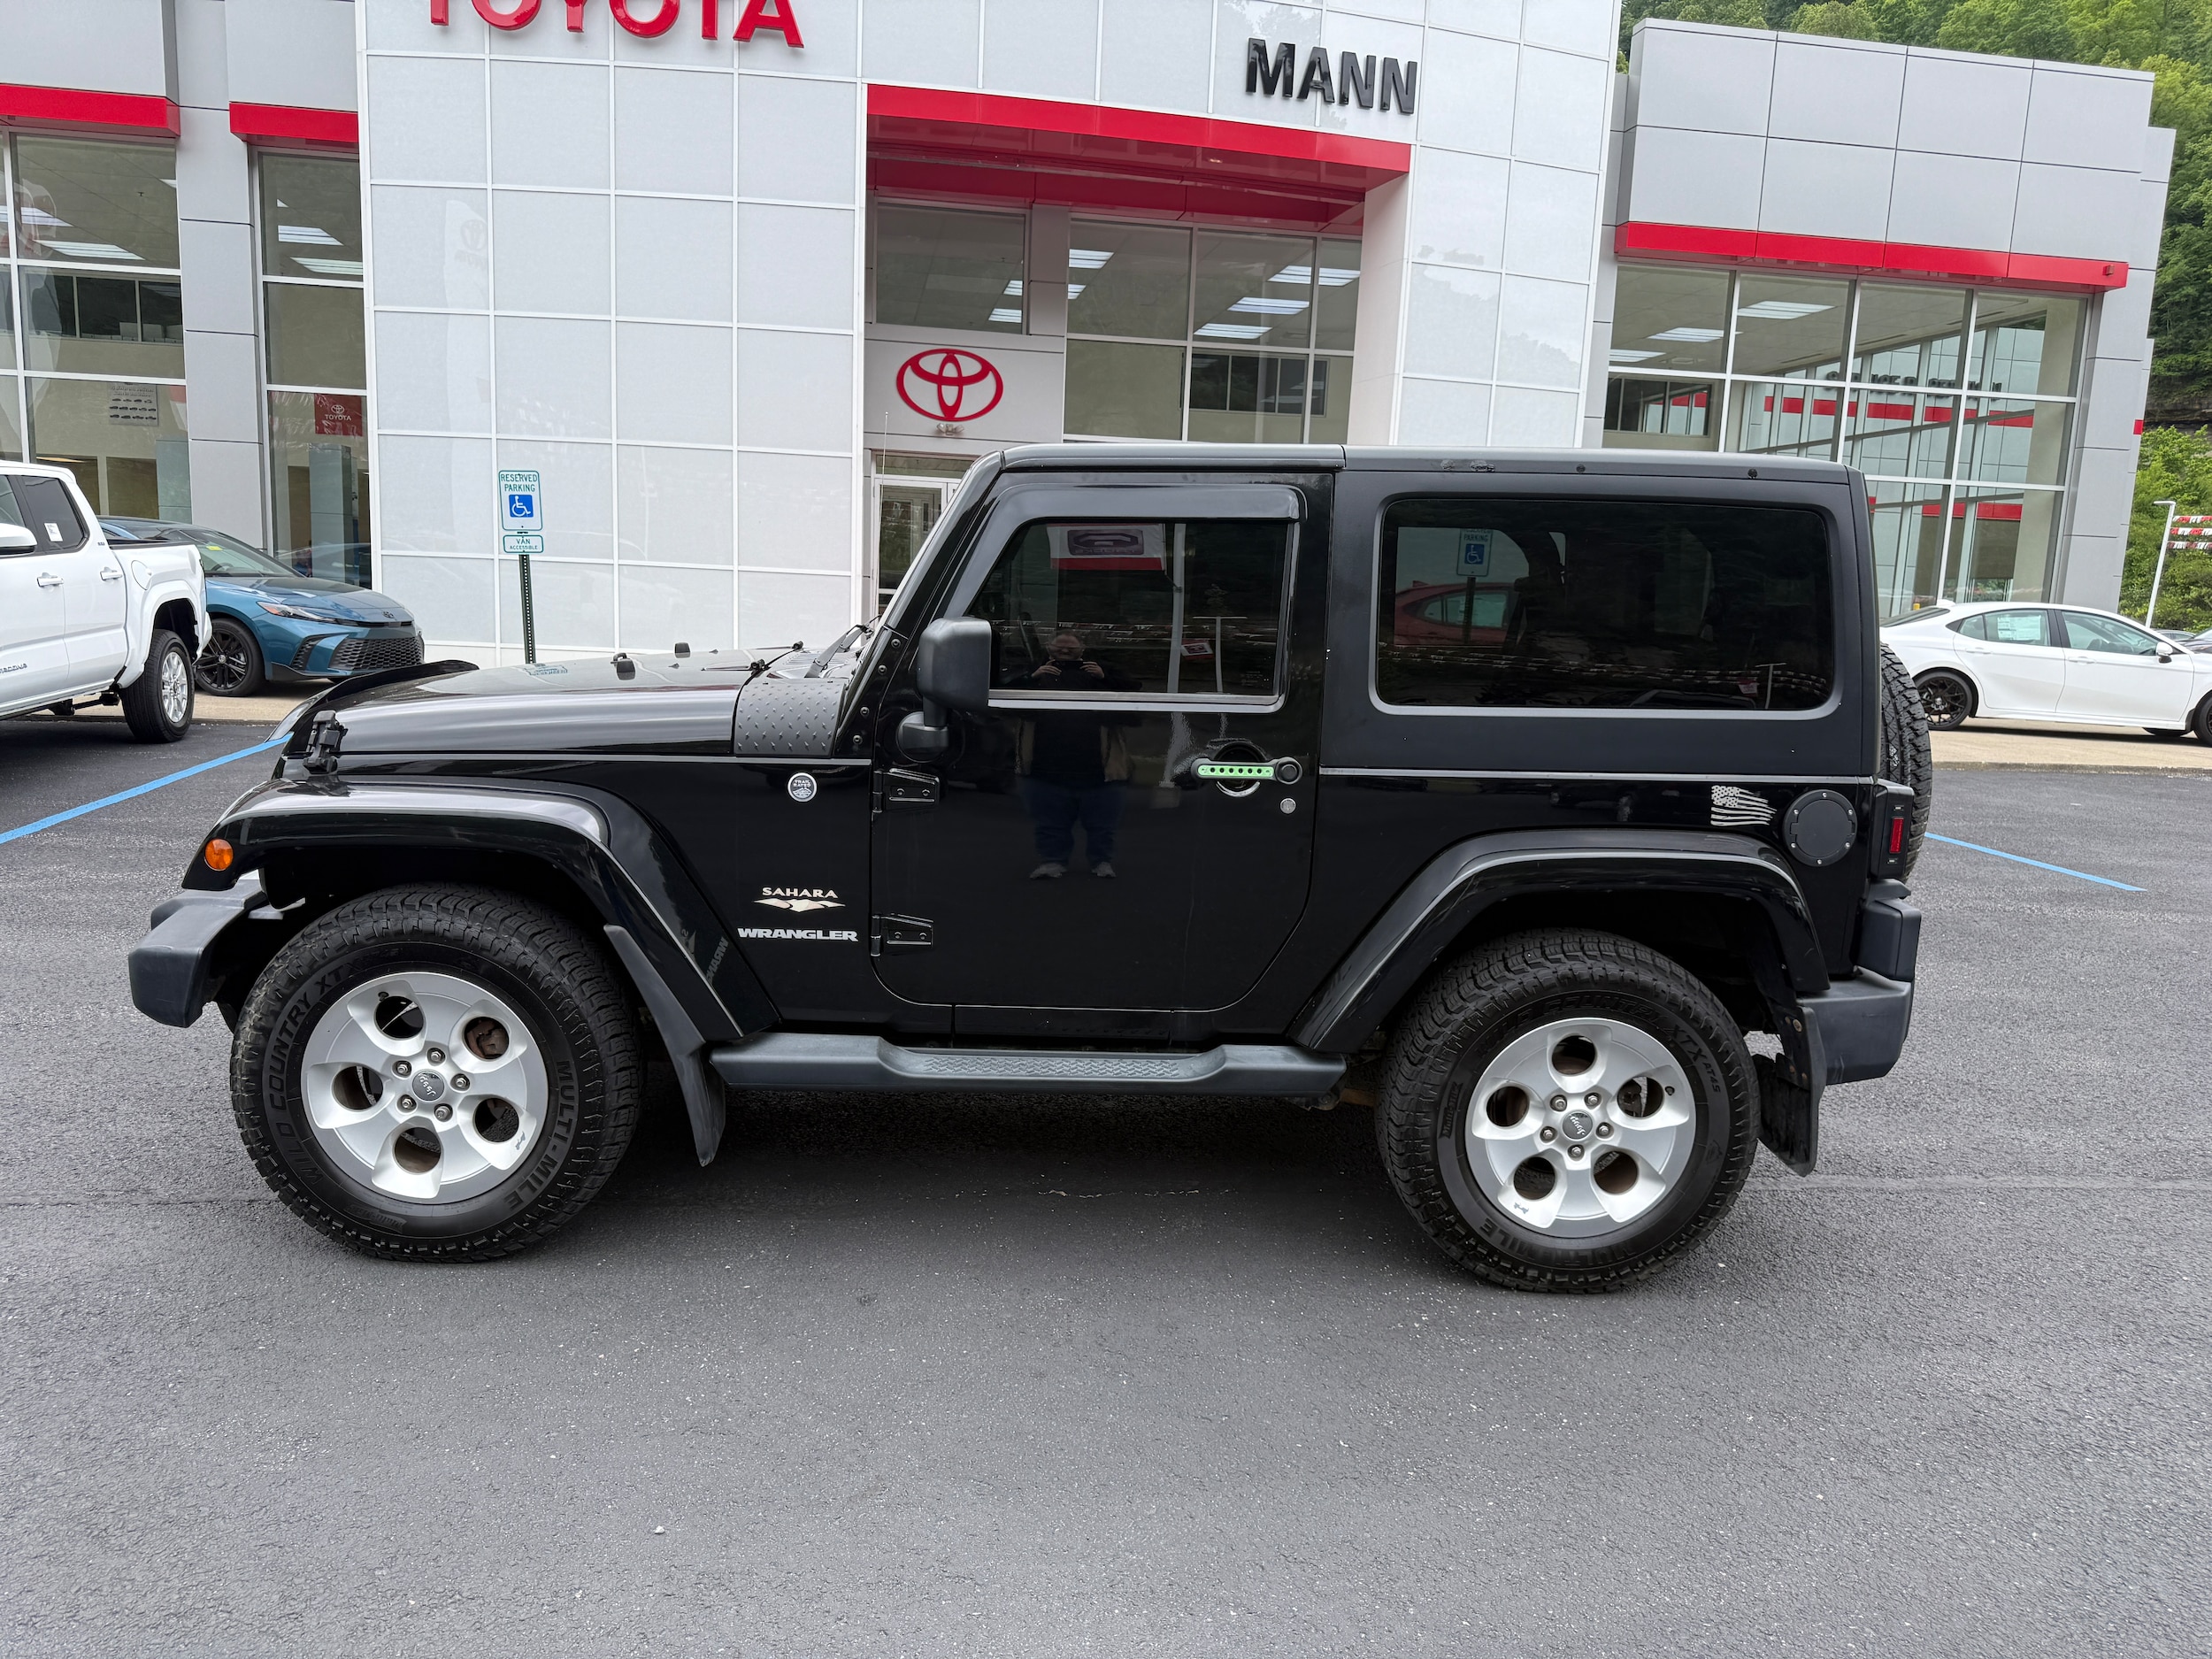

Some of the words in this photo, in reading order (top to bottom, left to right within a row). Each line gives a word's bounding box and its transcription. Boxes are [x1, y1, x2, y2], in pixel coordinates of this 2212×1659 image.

[1245, 37, 1417, 114] MANN
[500, 473, 538, 482] RESERVED
[762, 887, 839, 899] SAHARA
[737, 927, 859, 942] WRANGLER
[270, 995, 314, 1110] COUNTRY
[1668, 1023, 1709, 1063] XTX
[277, 1121, 325, 1186] WILD
[504, 1059, 575, 1211] MULTI-MILE
